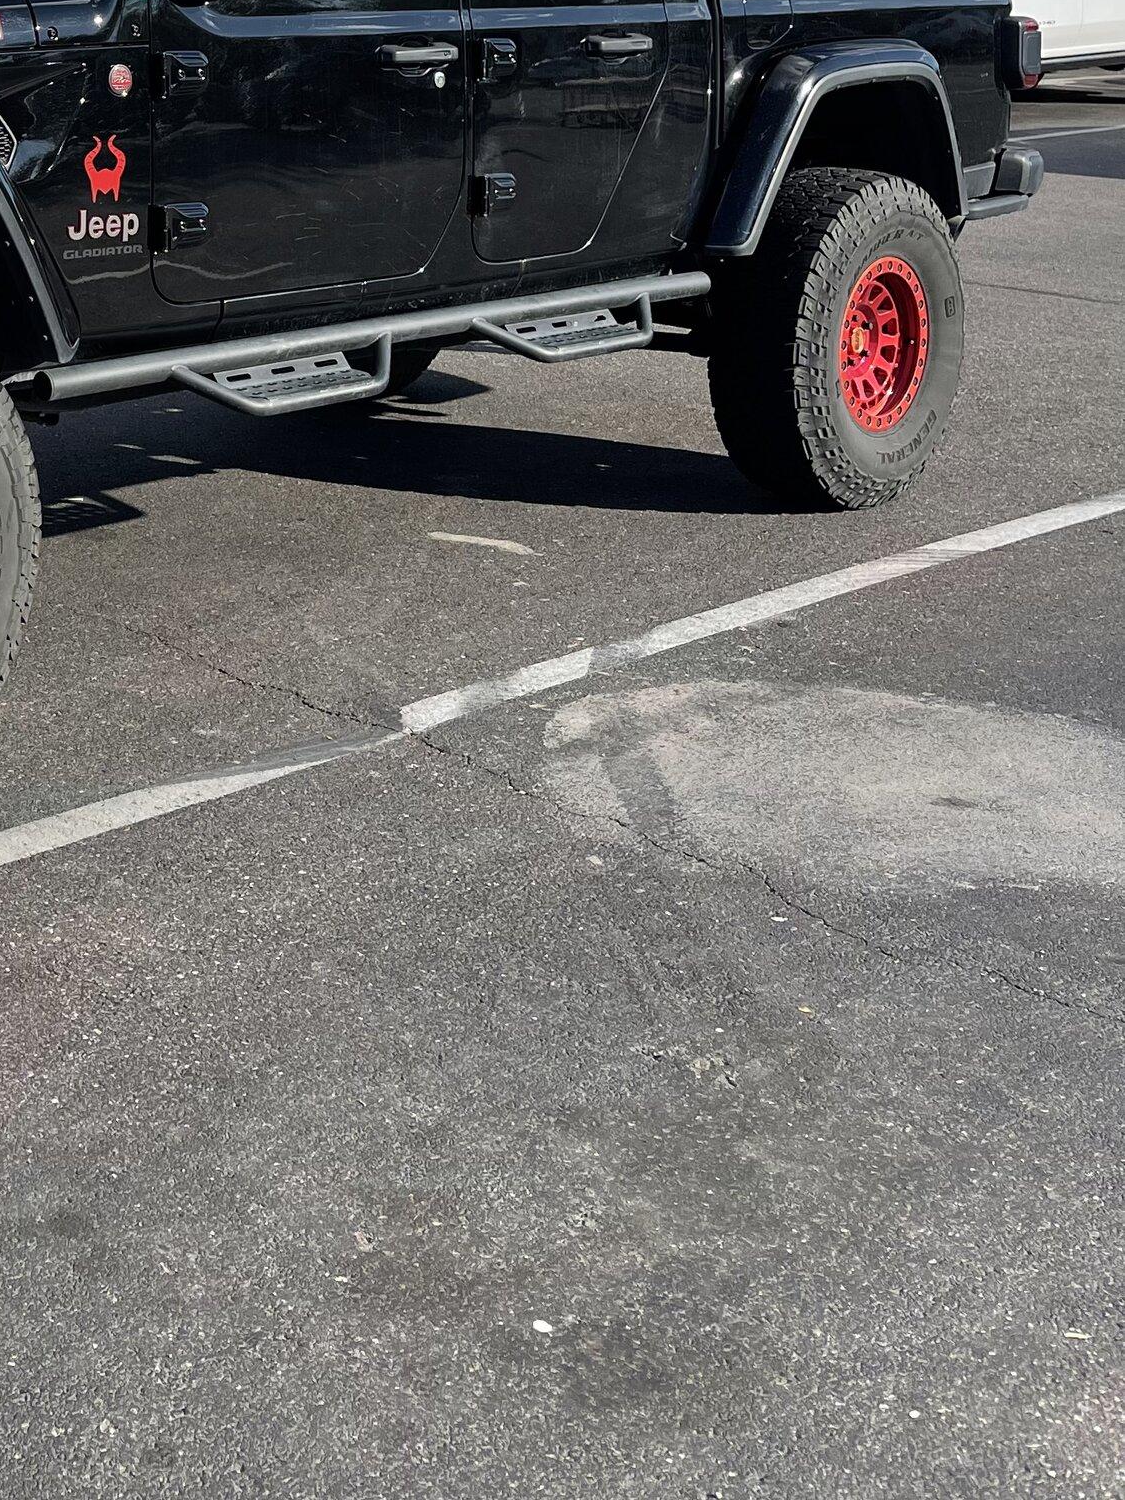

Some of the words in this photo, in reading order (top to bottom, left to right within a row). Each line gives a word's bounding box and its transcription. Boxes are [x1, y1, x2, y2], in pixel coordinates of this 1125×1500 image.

[67, 209, 140, 242] Jeep
[62, 244, 144, 261] GLADIATOR
[876, 409, 937, 465] GENERAL
